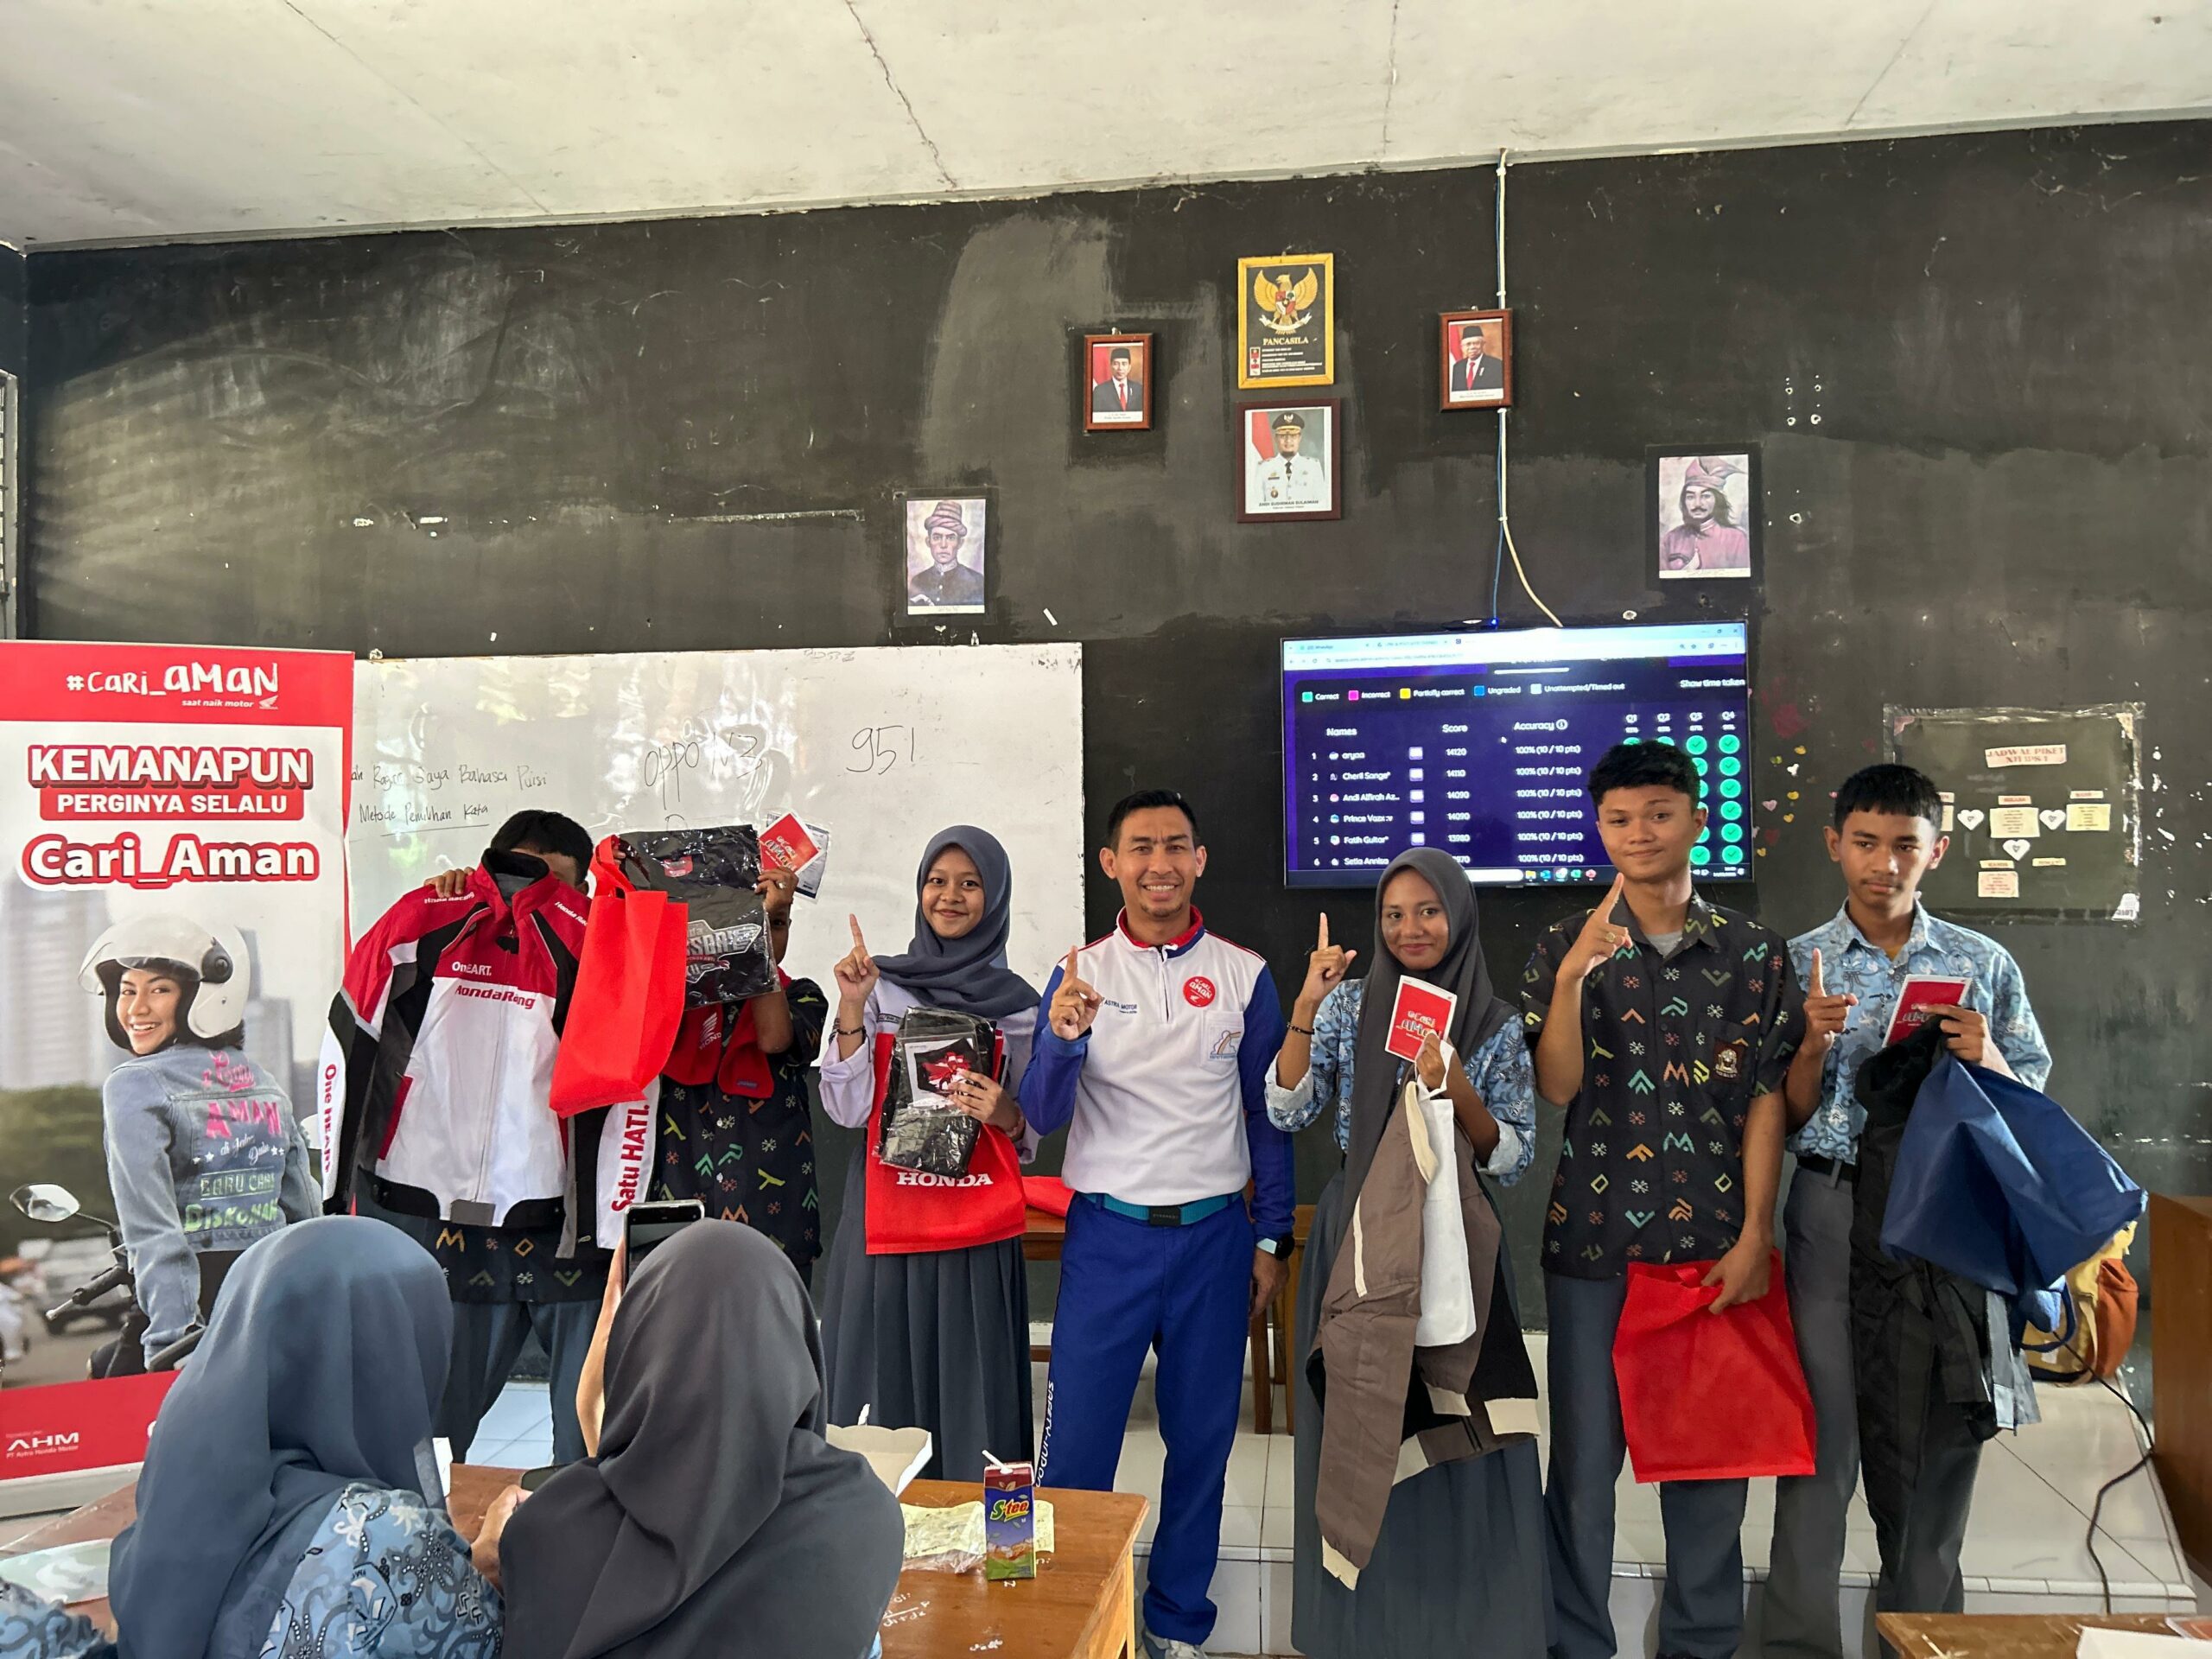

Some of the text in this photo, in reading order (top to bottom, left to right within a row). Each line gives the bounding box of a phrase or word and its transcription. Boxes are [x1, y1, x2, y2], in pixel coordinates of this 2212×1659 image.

[1263, 337, 1308, 346] PANCASILA
[1680, 677, 1745, 688] Show time taken
[1413, 688, 1465, 697] Partially correct
[1488, 686, 1522, 696] Ungraded
[1315, 692, 1339, 701] Correct
[1657, 713, 1670, 722] Q2
[1689, 712, 1703, 721] Q3
[1721, 711, 1735, 721] Q4
[1442, 724, 1468, 733] Score
[1514, 721, 1554, 731] Accuracy
[1326, 728, 1357, 736] Names
[1516, 746, 1535, 754] 100%
[2035, 747, 2063, 755] PIKET
[30, 747, 310, 785] KEMANAPUN
[645, 741, 699, 810] OPPO
[1516, 789, 1536, 798] 100%
[57, 793, 287, 813] PERGINYA SELALU
[359, 803, 397, 823] Metode
[463, 804, 488, 820] Kata
[1517, 810, 1537, 819] 100%
[1517, 832, 1538, 841] 100%
[29, 837, 315, 883] Cari_Aman
[555, 901, 577, 918] Honda
[1104, 1000, 1120, 1008] ASTRA
[699, 1032, 722, 1051] HOND
[207, 1099, 283, 1139] AMAN
[611, 1105, 650, 1211] Satu HATI.
[897, 1172, 993, 1187] HONDA
[200, 1174, 245, 1197] BARU
[7, 1432, 79, 1452] AHM
[990, 1498, 1029, 1522] S-tee
